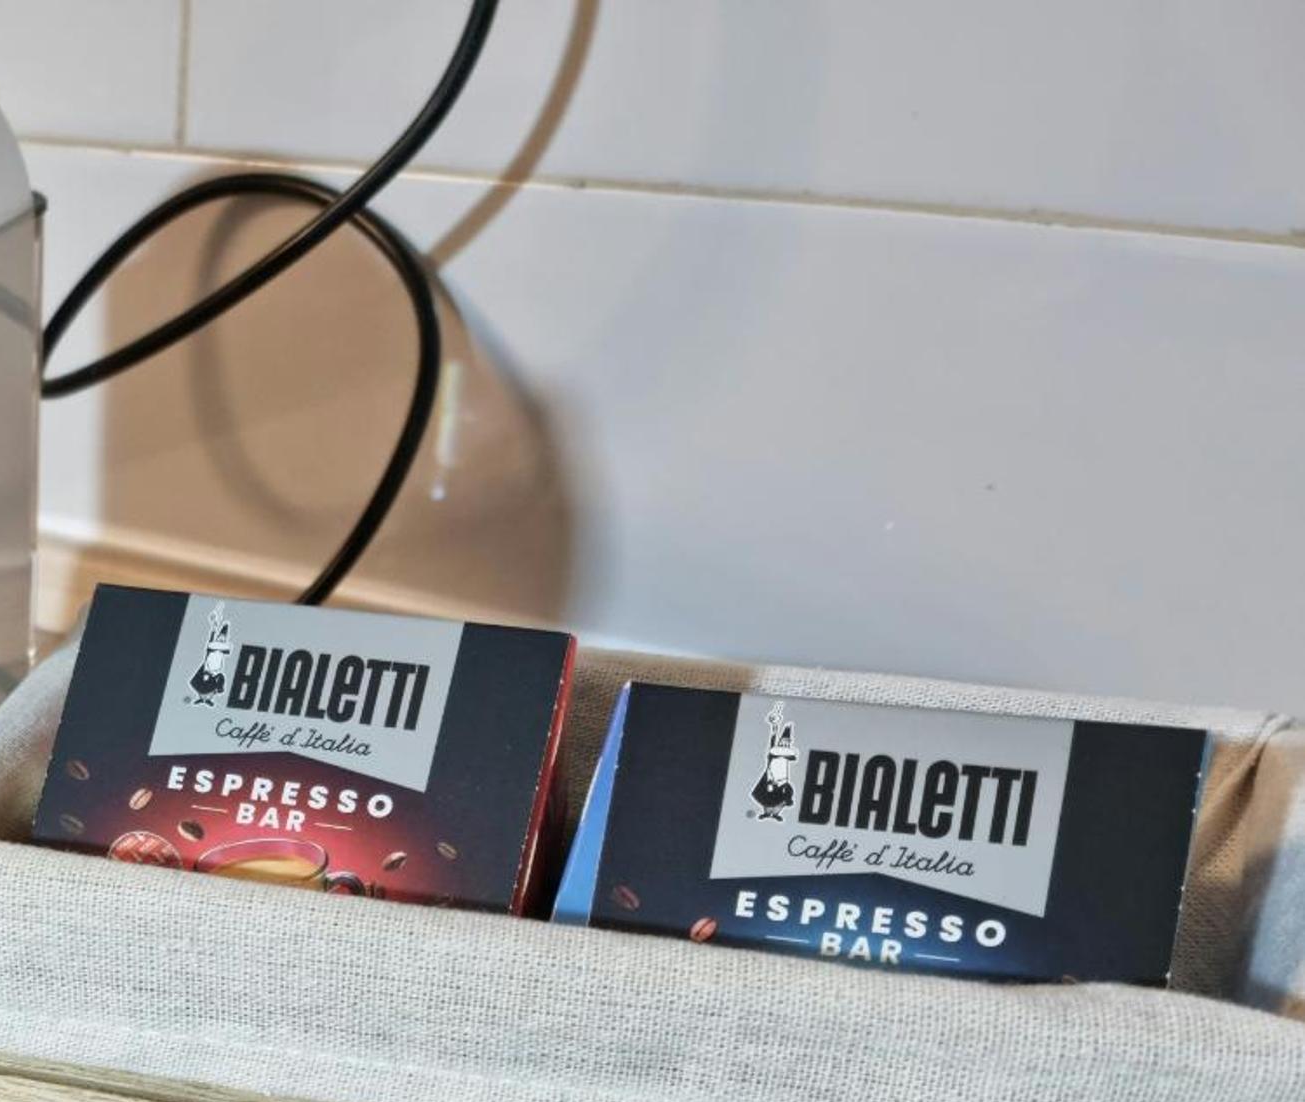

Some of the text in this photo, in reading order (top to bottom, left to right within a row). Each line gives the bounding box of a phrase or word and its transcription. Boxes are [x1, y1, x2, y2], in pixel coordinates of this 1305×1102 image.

[167, 766, 394, 818] ESPRESSO
[236, 803, 306, 832] BAR
[735, 890, 1006, 948] ESPRESSO
[820, 932, 903, 964] BAR
